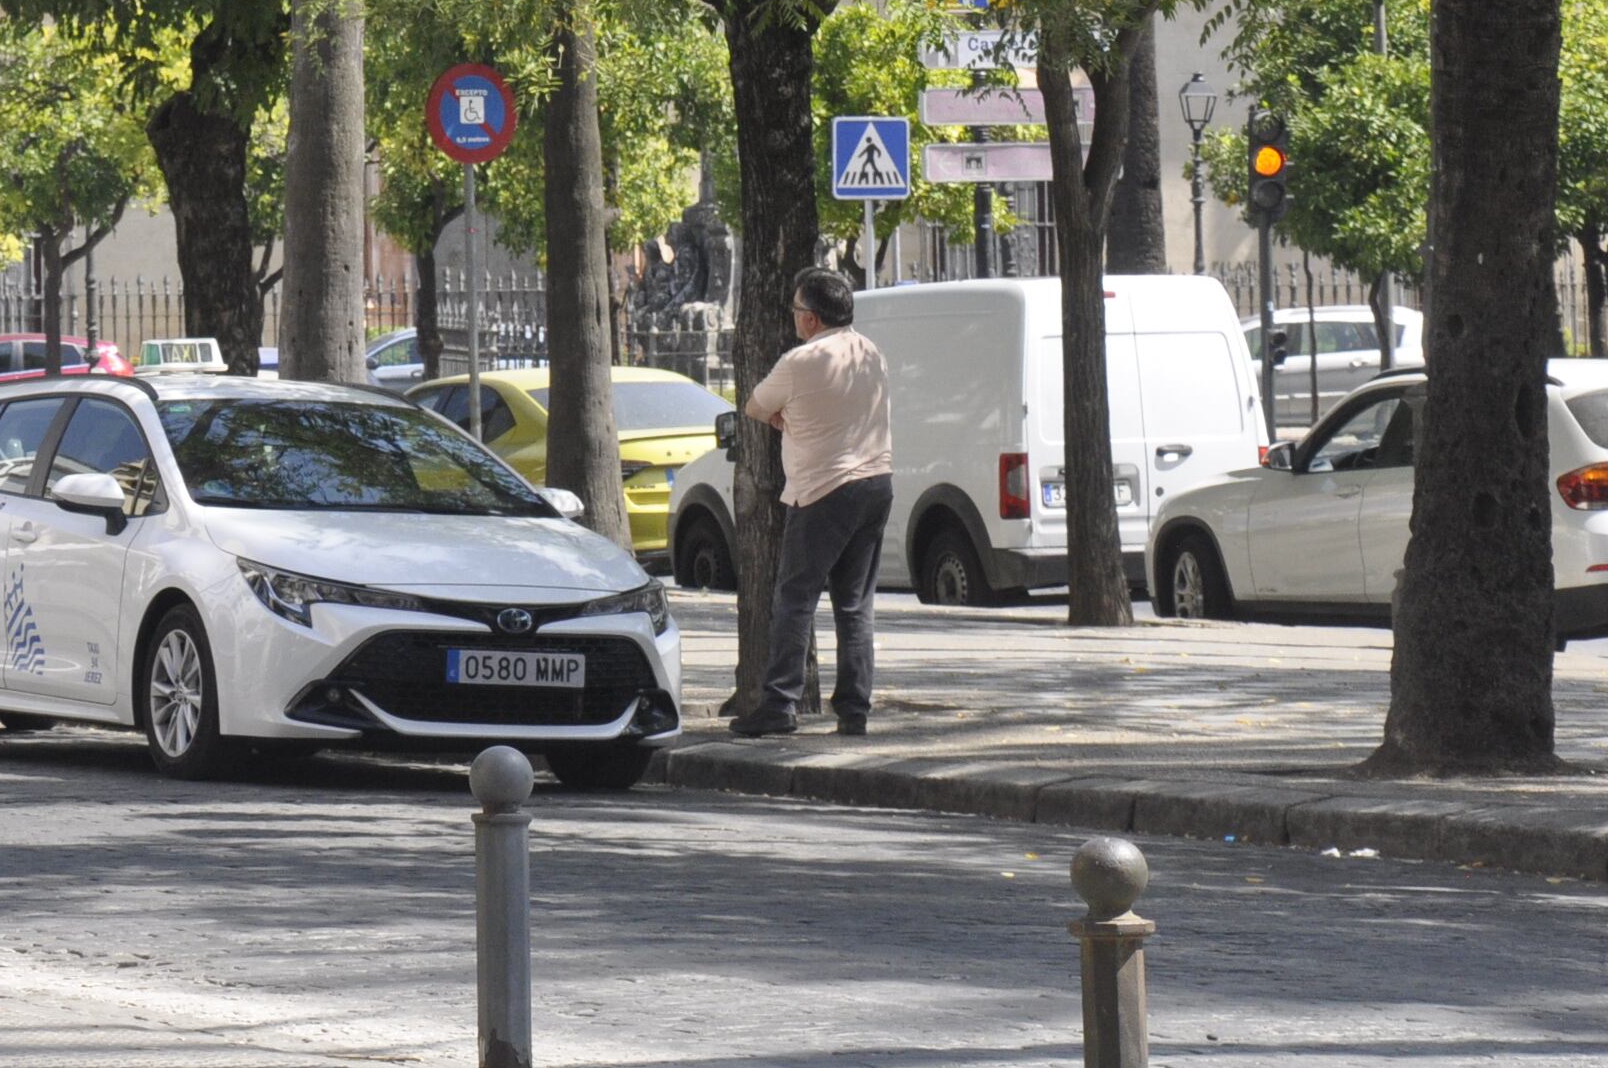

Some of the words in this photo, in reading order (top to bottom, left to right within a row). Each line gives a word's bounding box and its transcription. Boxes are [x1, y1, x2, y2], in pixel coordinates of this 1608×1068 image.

[163, 344, 198, 363] TAXI
[86, 641, 101, 654] TAXI
[464, 655, 527, 681] 0580
[535, 657, 579, 682] MMP
[83, 670, 102, 685] JEREZ
